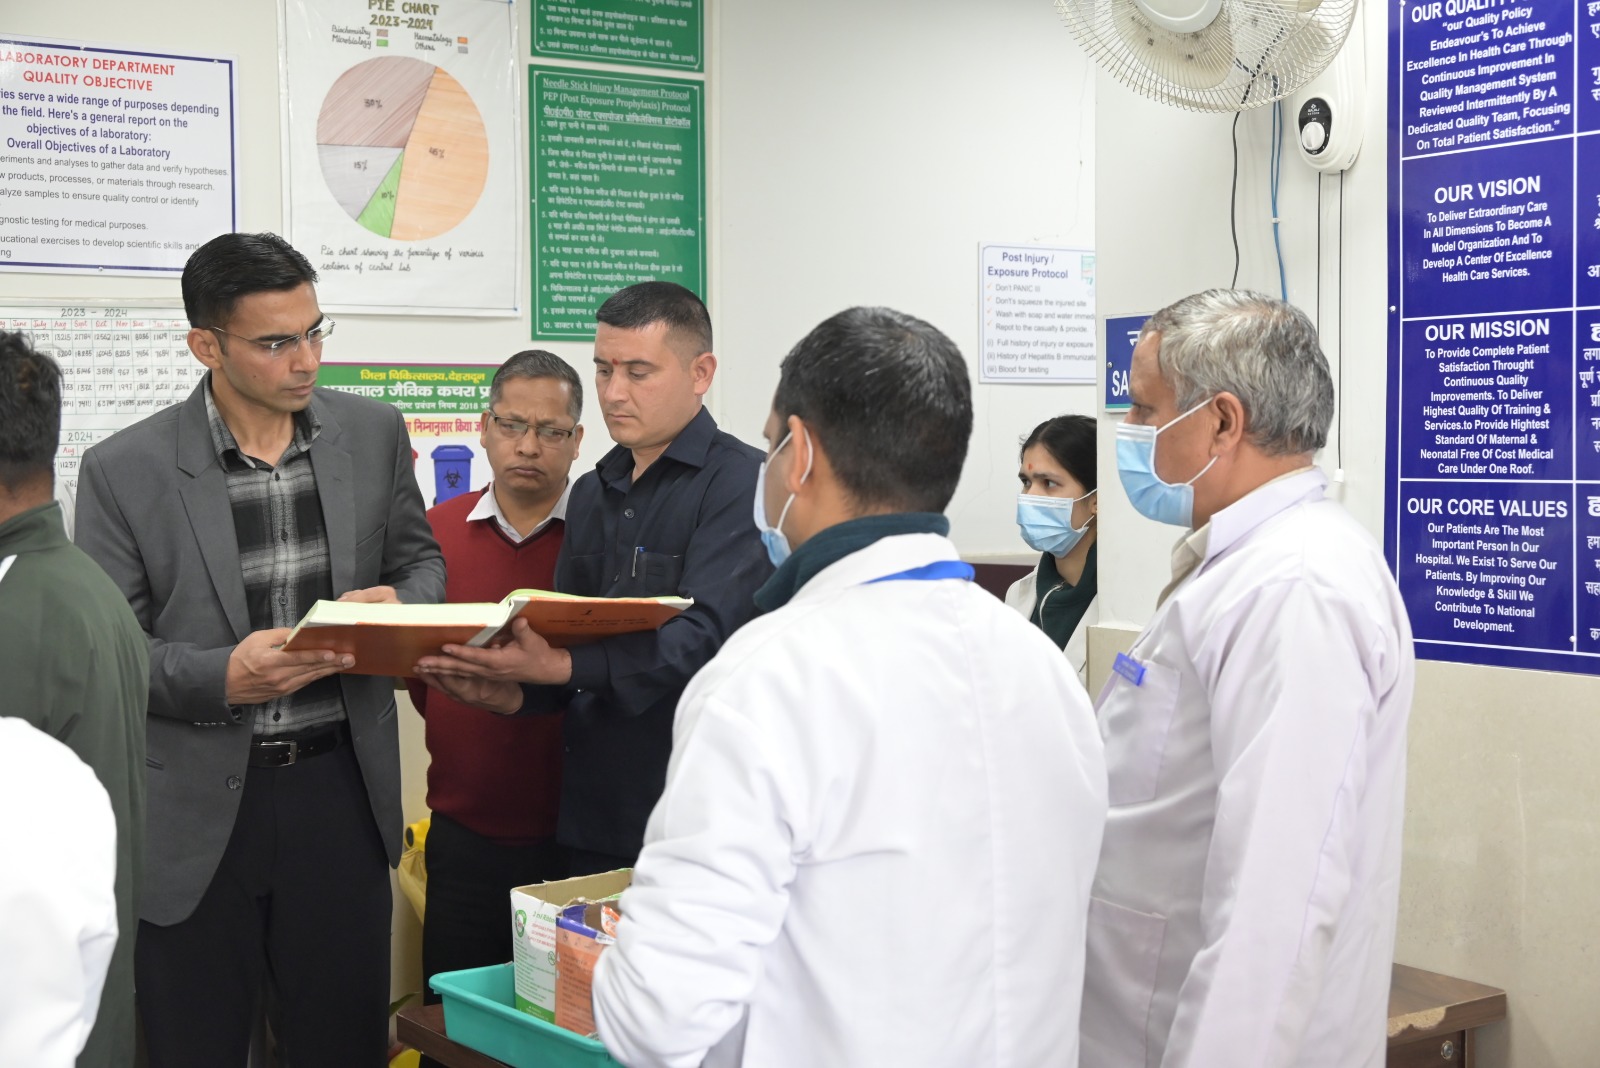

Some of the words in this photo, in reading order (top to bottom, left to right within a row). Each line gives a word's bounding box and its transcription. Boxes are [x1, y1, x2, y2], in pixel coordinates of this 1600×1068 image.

[368, 0, 394, 11] PIE
[401, 2, 439, 15] CHART
[1412, 2, 1442, 22] OUR
[1465, 13, 1499, 27] Quality
[1502, 7, 1532, 20] Policy
[369, 15, 433, 30] 2023-2024
[1491, 28, 1503, 39] To
[1505, 21, 1545, 37] Achieve
[1407, 55, 1456, 71] Excellence
[1458, 52, 1467, 62] In
[1470, 45, 1500, 60] Health
[1503, 42, 1526, 54] Care
[1528, 33, 1572, 49] Through
[0, 51, 88, 68] LABORATORY
[92, 58, 175, 76] DEPARTMENT
[1421, 68, 1475, 84] Continuous
[1478, 54, 1542, 75] Improvement
[1545, 53, 1554, 63] In
[23, 70, 78, 84] QUALITY
[83, 75, 152, 91] OBJECTIVE
[543, 78, 568, 89] Needle
[570, 80, 588, 91] Stick
[590, 82, 612, 94] Injury
[613, 84, 659, 98] Management
[660, 88, 689, 100] Protocol
[18, 92, 45, 101] serve
[48, 94, 53, 102] a
[56, 93, 79, 104] wide
[82, 97, 109, 108] range
[112, 97, 121, 107] of
[124, 100, 167, 111] purposes
[171, 102, 218, 117] depending
[543, 91, 558, 100] PEP
[559, 93, 578, 103] (Post
[580, 94, 614, 106] Exposure
[616, 97, 660, 112] Prophylaxis)
[662, 102, 690, 112] Protocol
[2, 104, 18, 115] the
[20, 106, 44, 117] field.
[48, 108, 78, 120] Here's
[81, 112, 86, 120] a
[90, 113, 125, 123] general
[128, 116, 156, 126] report
[159, 118, 170, 126] on
[173, 118, 187, 127] the
[26, 124, 76, 136] objectives
[79, 128, 89, 136] of
[92, 129, 97, 137] a
[100, 129, 150, 143] laboratory:
[7, 138, 41, 149] Overall
[45, 140, 96, 153] Objectives
[99, 144, 108, 153] of
[111, 146, 116, 154] a
[120, 145, 170, 160] Laboratory
[36, 157, 51, 165] and
[54, 158, 88, 168] analyses
[90, 160, 98, 168] to
[100, 161, 125, 170] gather
[127, 162, 143, 170] data
[162, 165, 182, 174] verify
[185, 166, 228, 175] hypotheses.
[1434, 184, 1473, 203] OUR
[1478, 175, 1540, 198] VISION
[1427, 212, 1437, 222] To
[1438, 210, 1467, 221] Deliver
[1469, 204, 1525, 218] Extraordinary
[1527, 202, 1547, 212] Care
[31, 217, 59, 227] testing
[61, 217, 72, 226] for
[75, 219, 106, 227] medical
[109, 222, 148, 230] purposes.
[1002, 252, 1022, 262] Post
[1024, 253, 1048, 265] Injury
[988, 266, 1029, 278] Exposure
[1032, 268, 1068, 278] Protocol
[61, 308, 85, 317] 2023
[104, 308, 127, 317] 2024
[1425, 324, 1464, 341] OUR
[1470, 318, 1549, 338] MISSION
[1424, 348, 1435, 358] To
[1438, 347, 1470, 358] Provide
[1472, 345, 1514, 358] Complete
[1517, 343, 1549, 354] Patient
[360, 369, 386, 380] जिला
[1111, 370, 1130, 397] SA
[388, 382, 433, 396] जैविक
[436, 382, 475, 397] कचरा
[1423, 406, 1456, 417] Highest
[1458, 404, 1489, 417] Quality
[1491, 404, 1502, 414] Of
[1504, 404, 1541, 416] Training
[1543, 403, 1550, 414] &
[414, 418, 453, 436] निम्नानुसार
[454, 418, 472, 432] किया
[1407, 498, 1442, 514] OUR
[1447, 498, 1494, 515] CORE
[1499, 500, 1567, 517] VALUES
[1427, 523, 1444, 532] Our
[1446, 523, 1481, 534] Patients
[1483, 524, 1499, 534] Are
[1502, 525, 1518, 535] The
[1521, 525, 1544, 536] Most
[1432, 538, 1474, 550] Important
[1476, 540, 1508, 551] Person
[1510, 541, 1519, 551] In
[1521, 542, 1539, 552] Our
